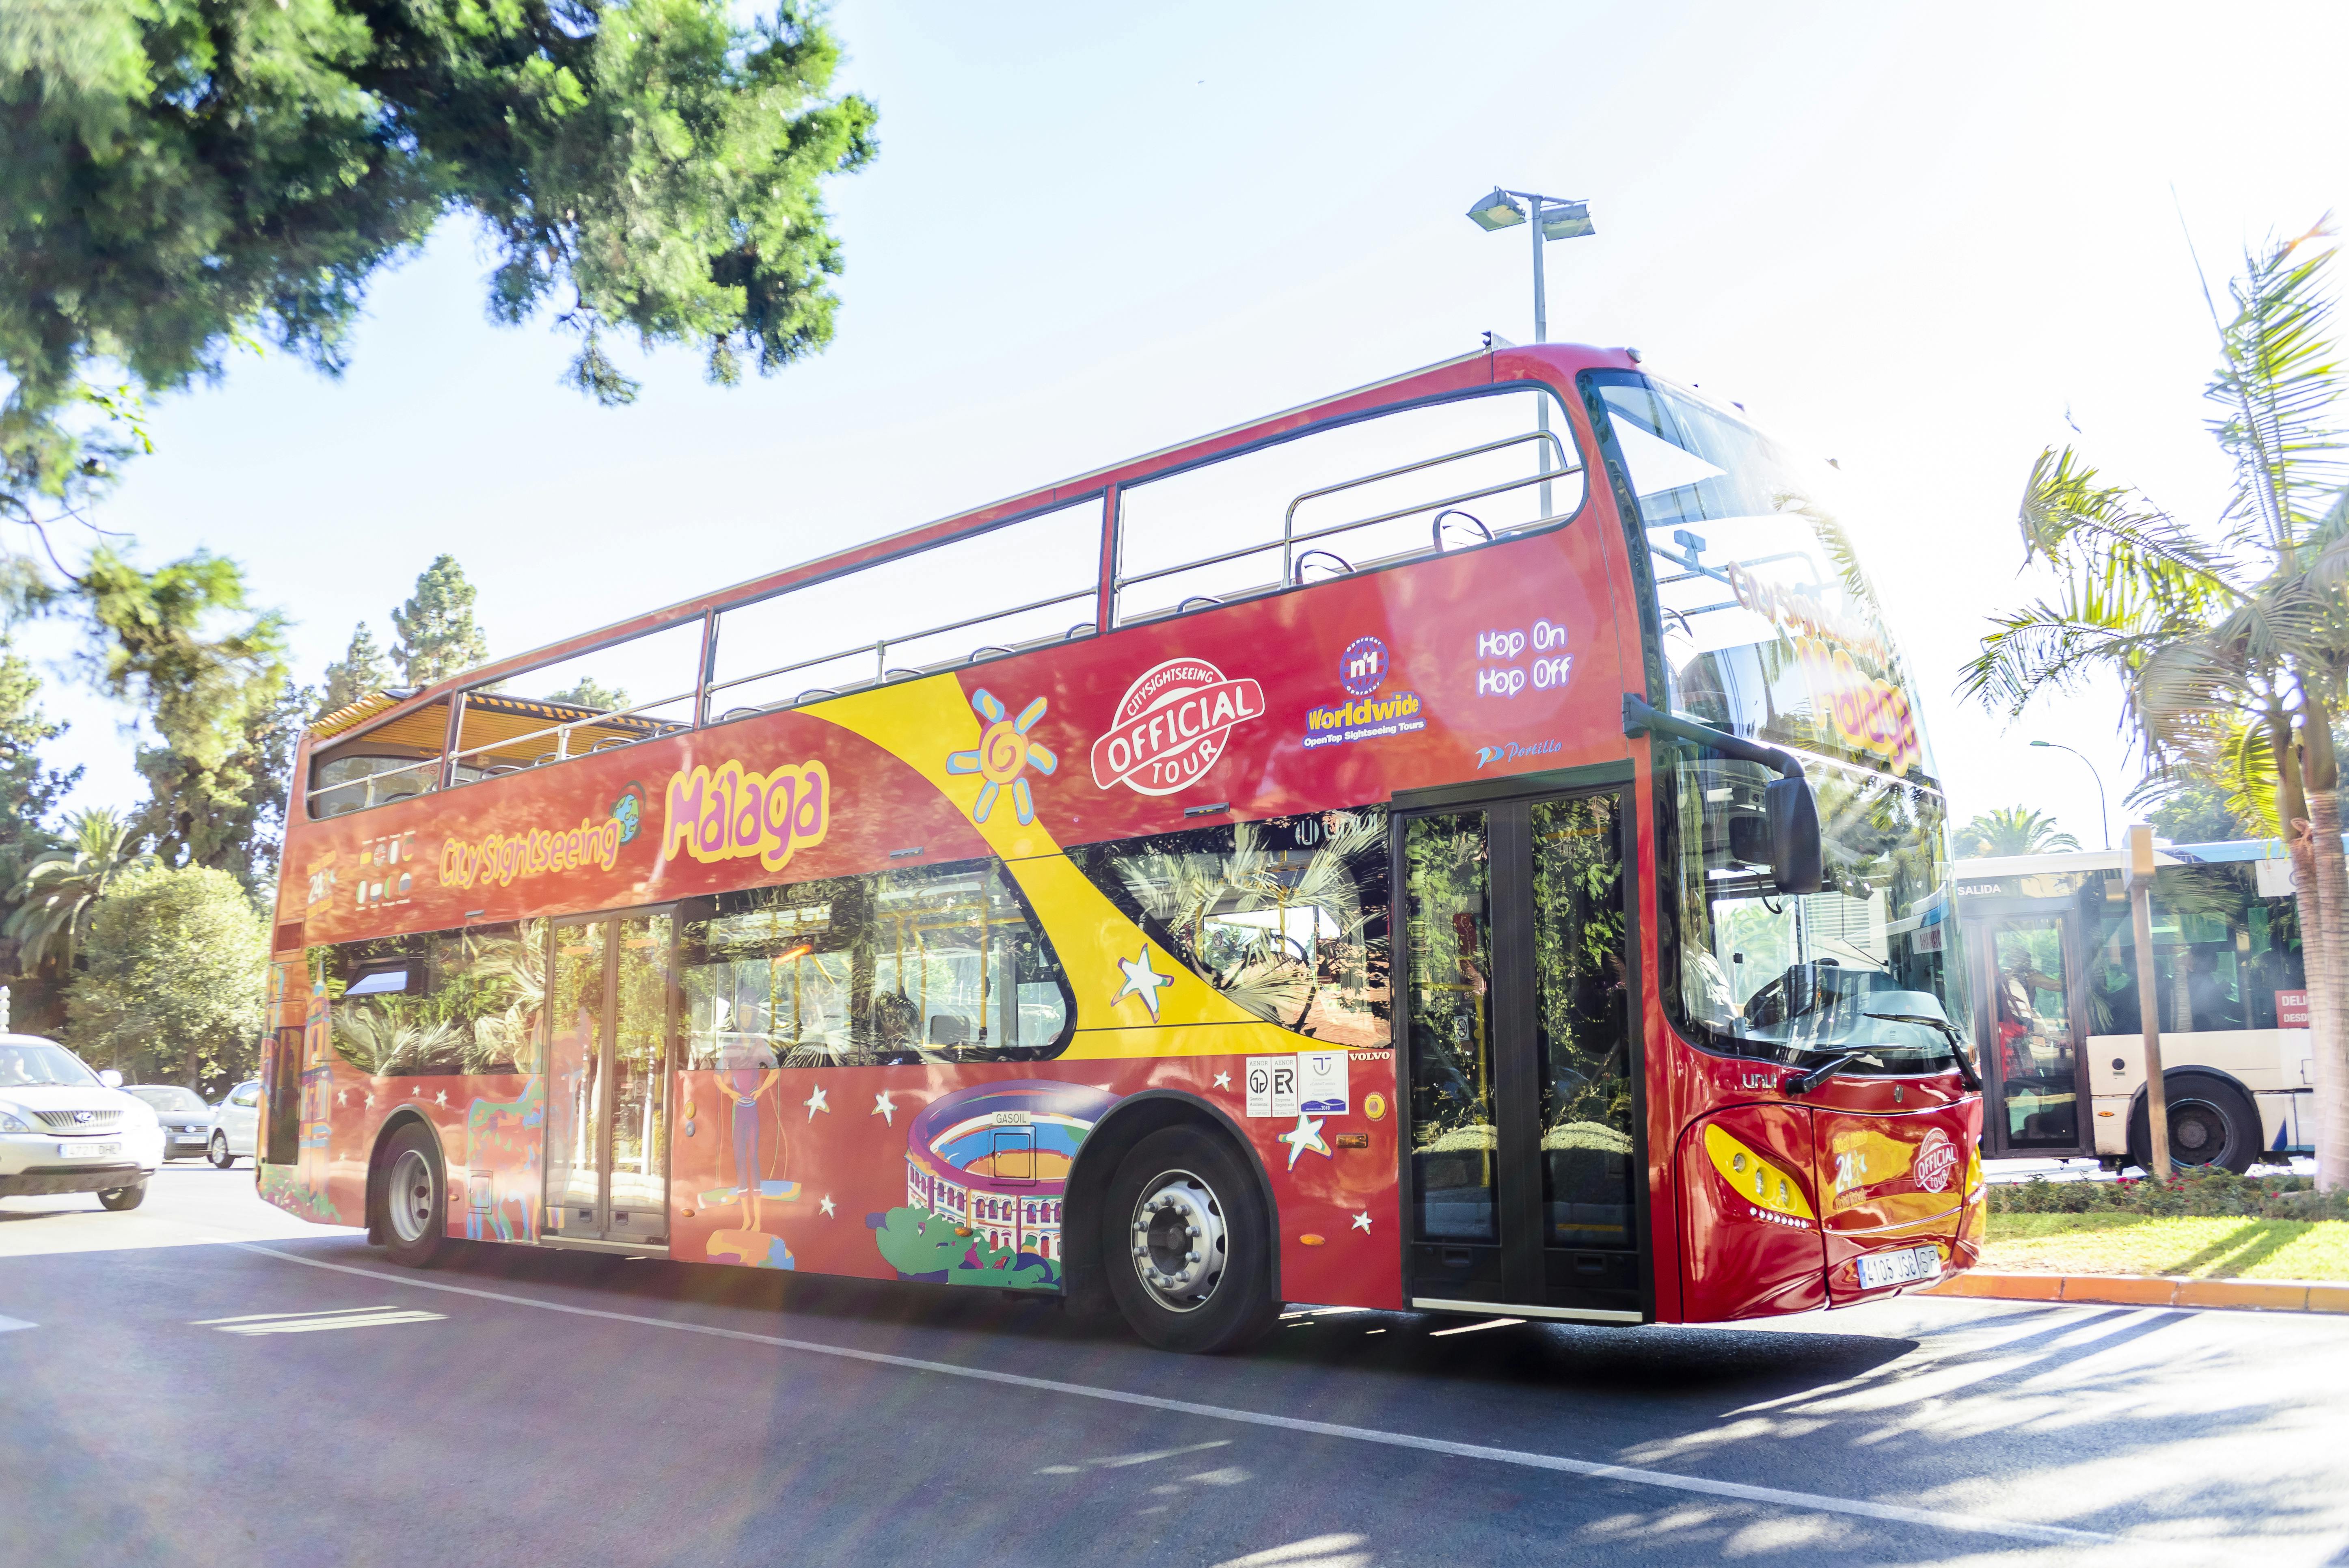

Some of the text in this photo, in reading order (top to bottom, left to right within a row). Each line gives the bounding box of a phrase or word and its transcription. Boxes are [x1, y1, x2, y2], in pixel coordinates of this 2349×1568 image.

[1479, 621, 1565, 658] Hop On
[1127, 667, 1213, 716] CITYSIGHTSEEING
[1479, 657, 1571, 696] Hop Off
[1108, 685, 1254, 773] OFFICIAL
[1308, 694, 1419, 730] Worldwide
[1304, 721, 1424, 747] OpenTop Sightseeing Tours
[1505, 739, 1562, 763] Portillo
[1153, 739, 1218, 784] TOUR
[666, 764, 826, 867] Málaga
[1957, 884, 2002, 896] SALIDA
[1349, 1052, 1390, 1061] VOLVO
[995, 1112, 1027, 1123] GASOIL
[1836, 1153, 1852, 1194] 24
[1918, 1146, 1956, 1179] OFFICIAL
[1930, 1169, 1947, 1188] TOUR
